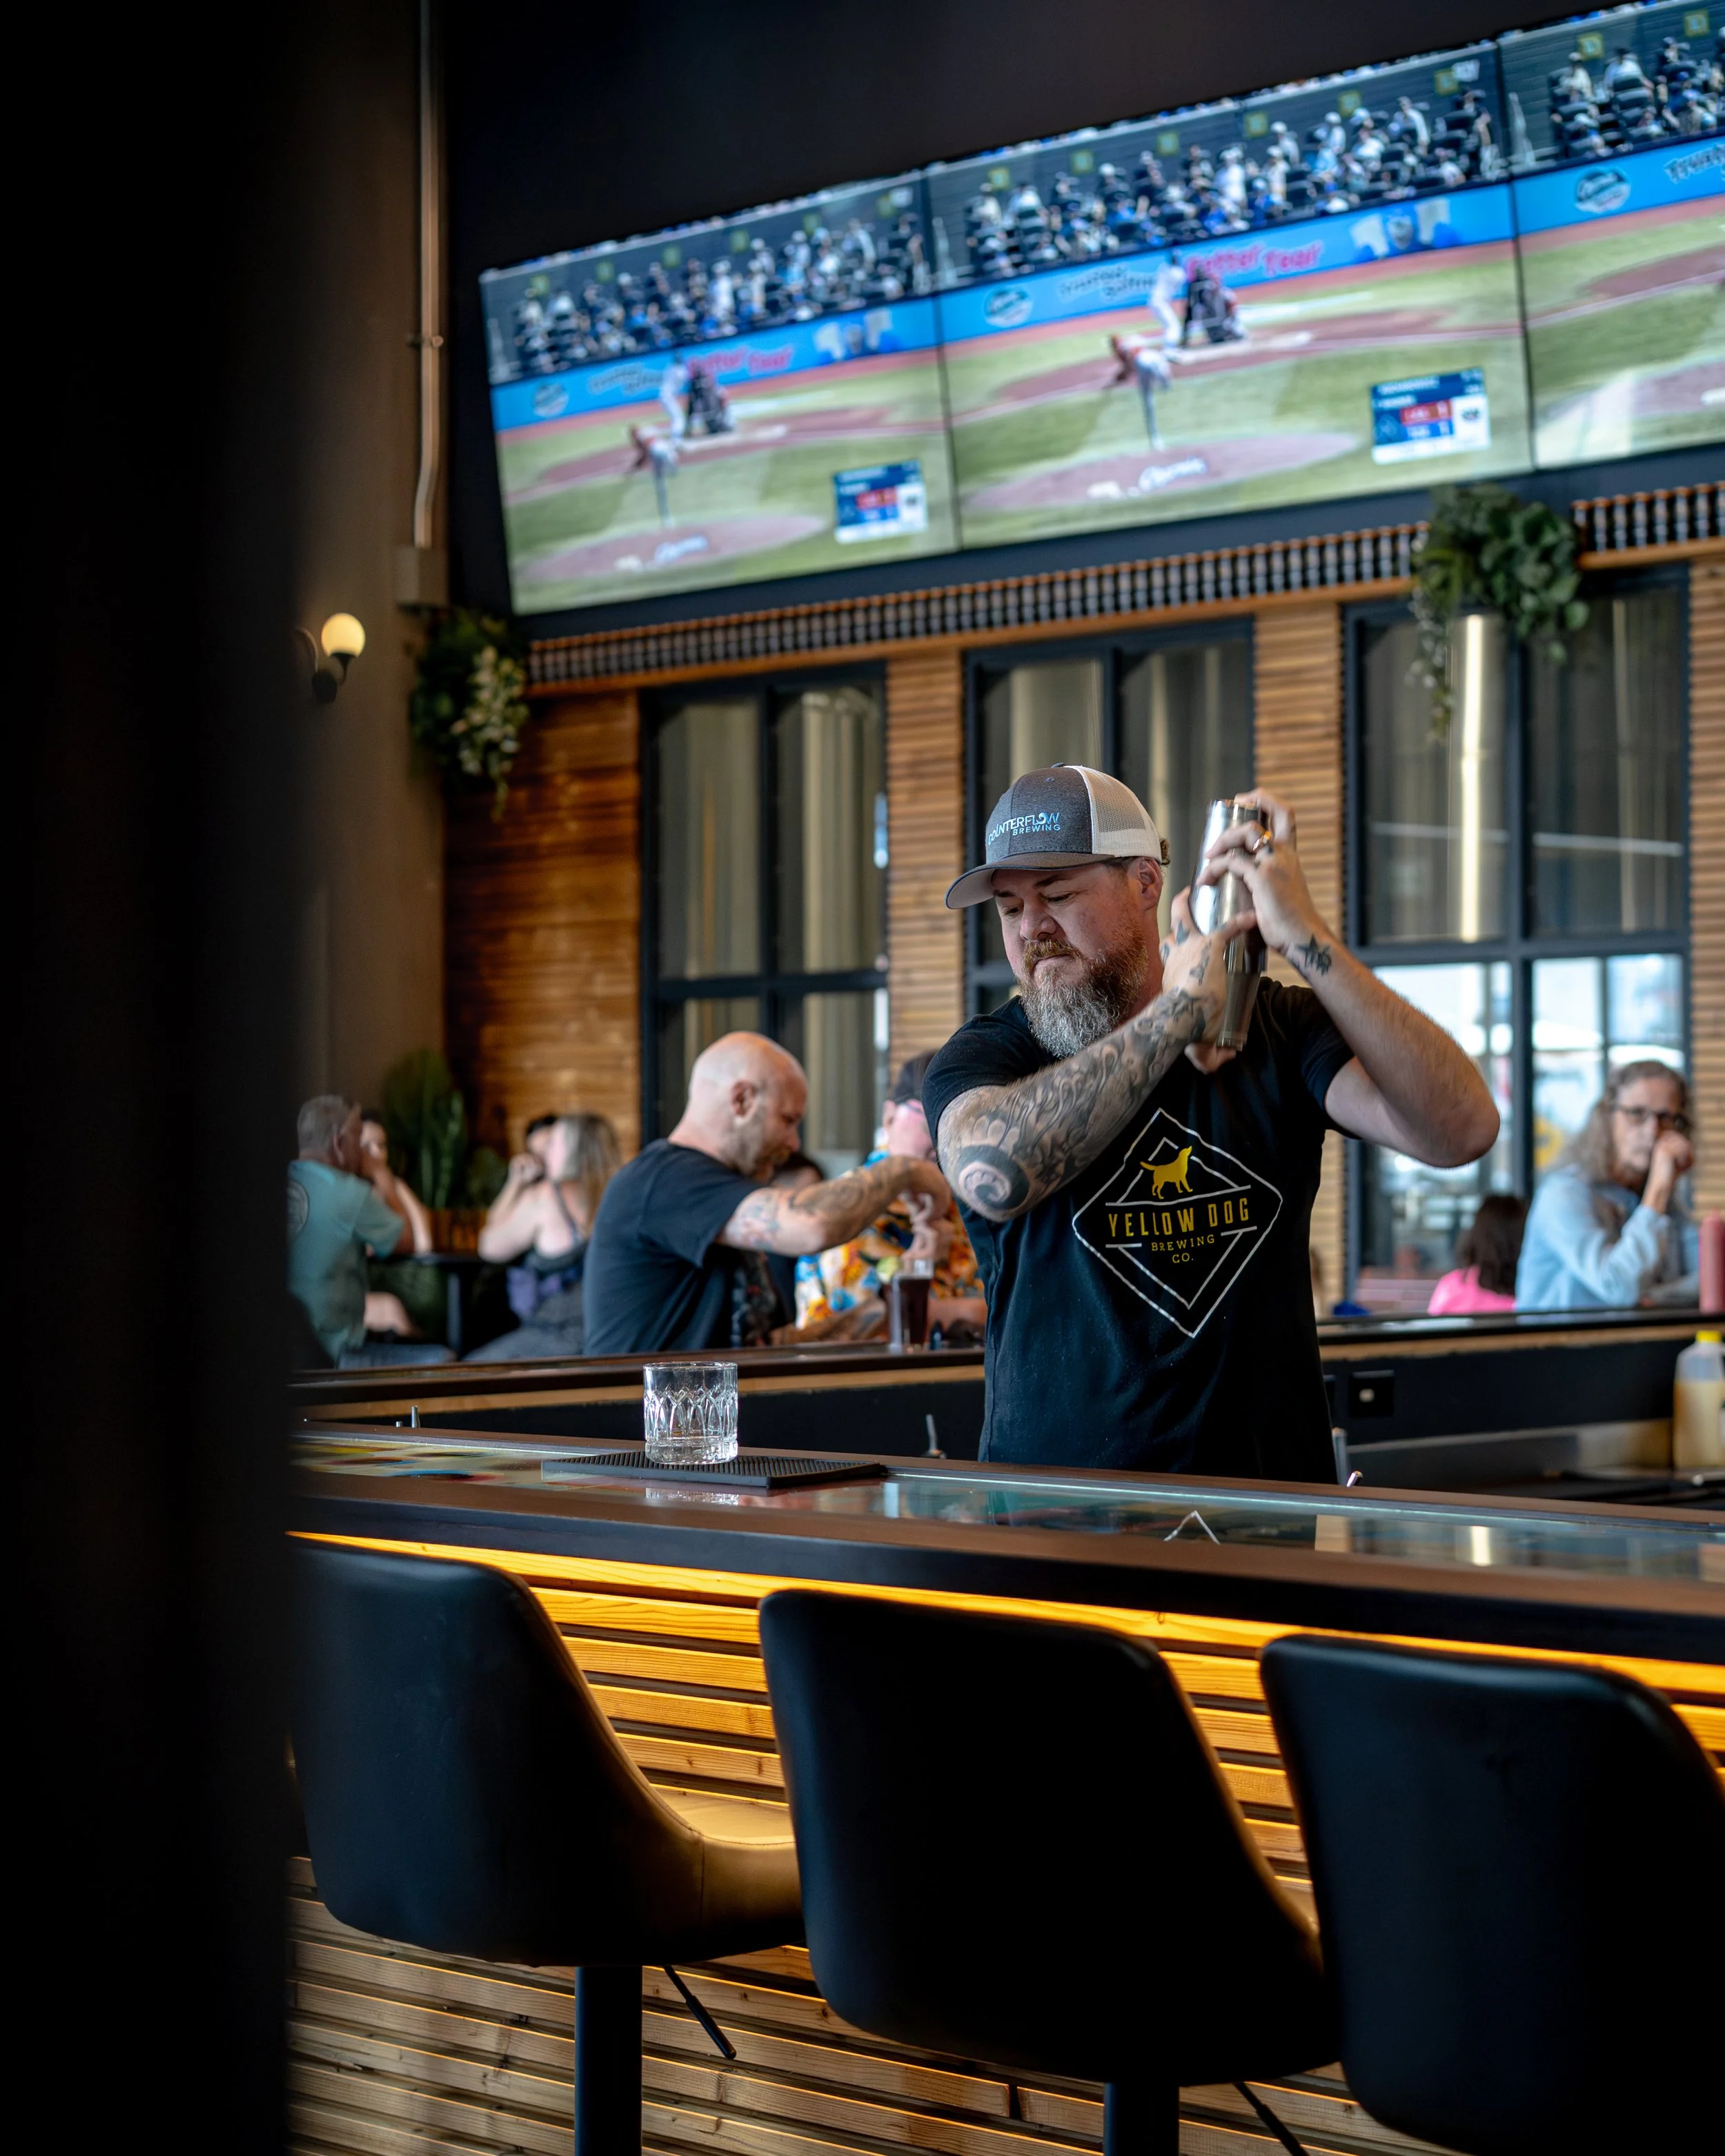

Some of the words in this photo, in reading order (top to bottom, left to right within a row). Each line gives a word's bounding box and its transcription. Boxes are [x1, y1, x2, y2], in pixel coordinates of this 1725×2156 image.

[988, 812, 1060, 845] COUNTERFLOW
[1012, 824, 1061, 835] BREWING
[1108, 1207, 1194, 1237] YELLOW
[1208, 1198, 1249, 1227] DOG
[1151, 1234, 1215, 1252] BREWING
[1172, 1252, 1194, 1263] CO.
